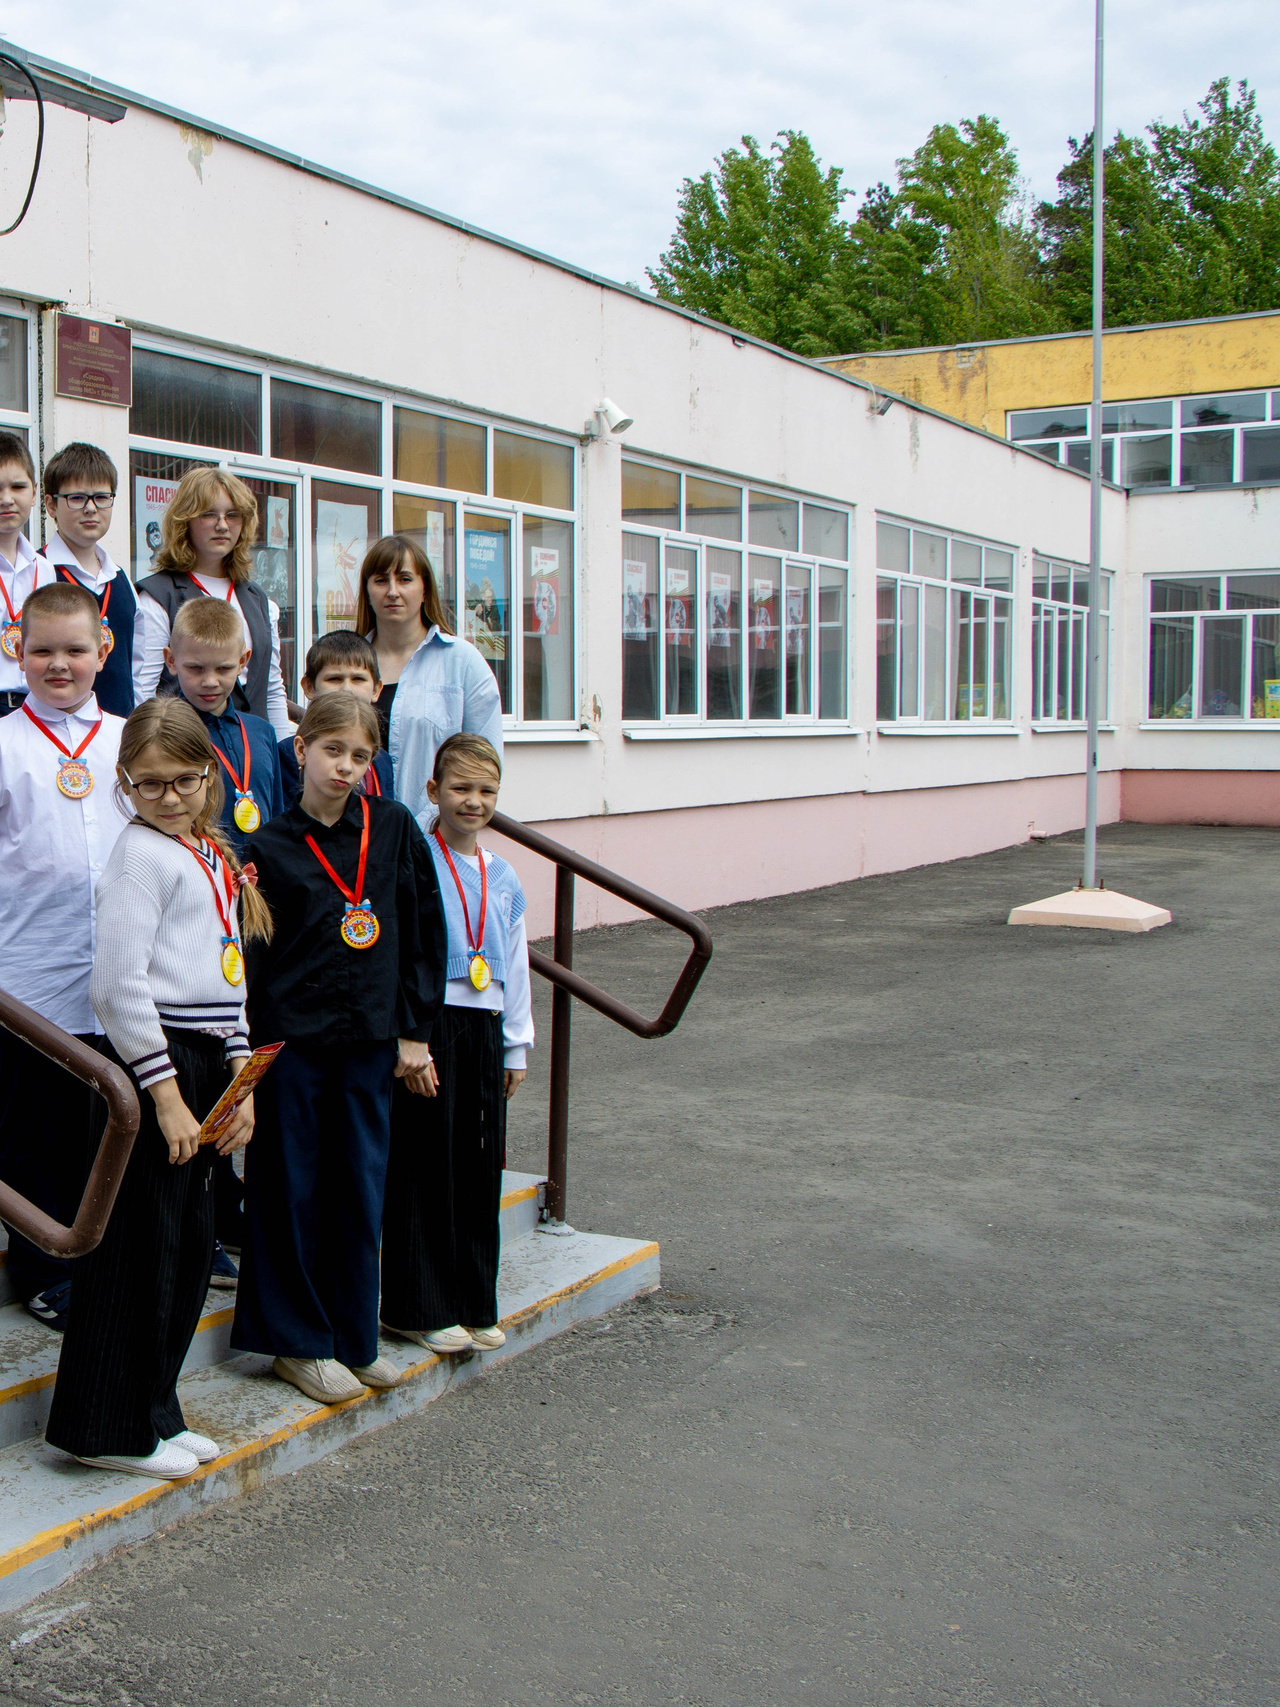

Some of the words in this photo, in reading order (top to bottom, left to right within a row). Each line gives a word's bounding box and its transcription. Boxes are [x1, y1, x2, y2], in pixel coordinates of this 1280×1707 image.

[146, 485, 177, 504] СПАСИ
[470, 534, 497, 548] ГОРДИМСЯ
[470, 548, 495, 562] ПОБЕДОЙ!
